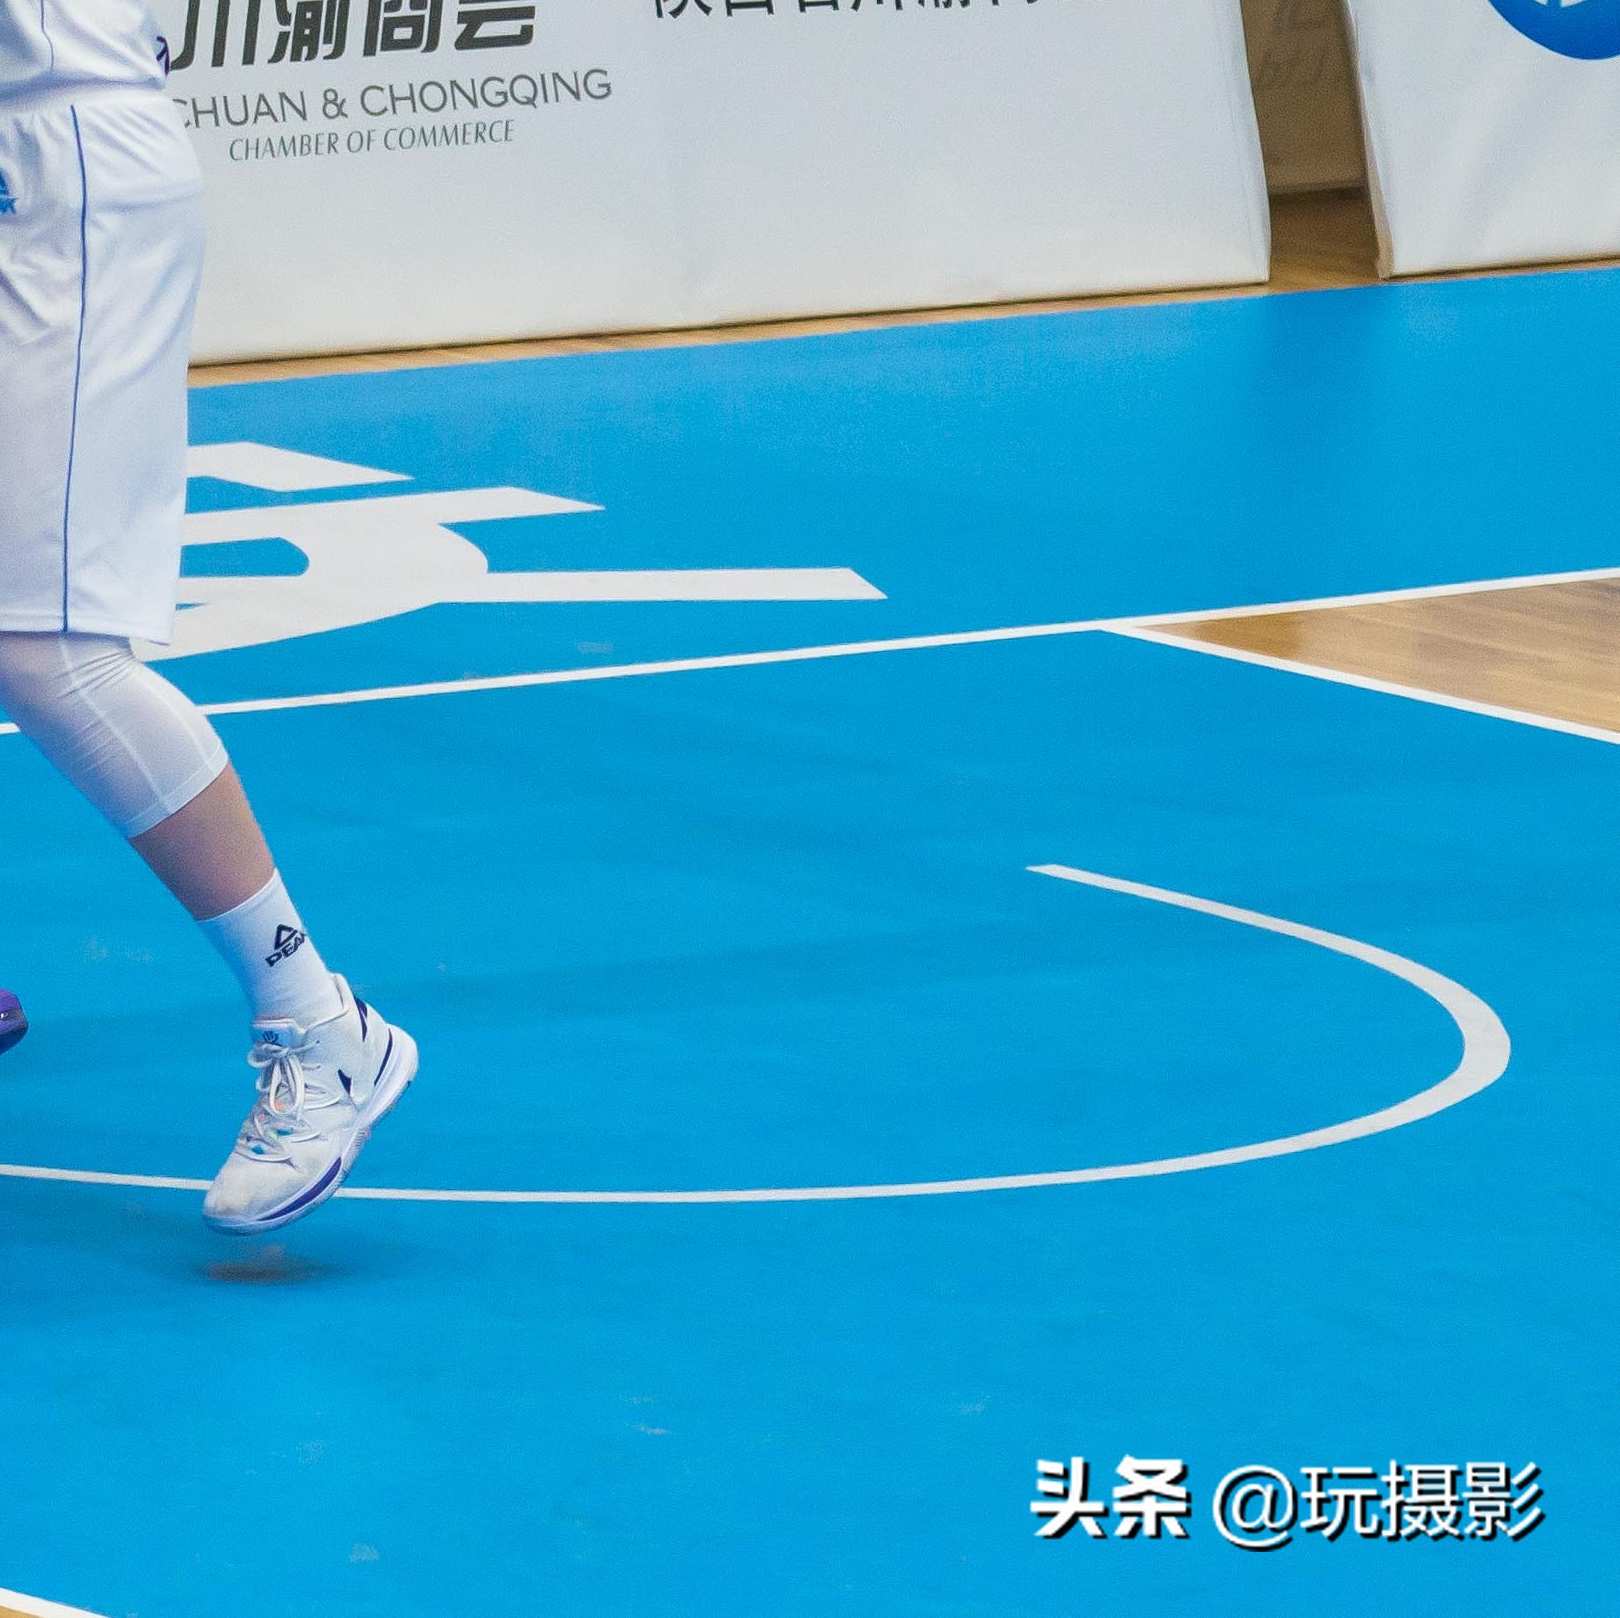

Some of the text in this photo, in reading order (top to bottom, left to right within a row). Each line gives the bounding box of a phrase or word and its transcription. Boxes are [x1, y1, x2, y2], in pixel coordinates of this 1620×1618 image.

[322, 87, 349, 121] &
[359, 68, 613, 118] CHONGQING
[229, 118, 516, 162] CHAMBER OF COMMERCE
